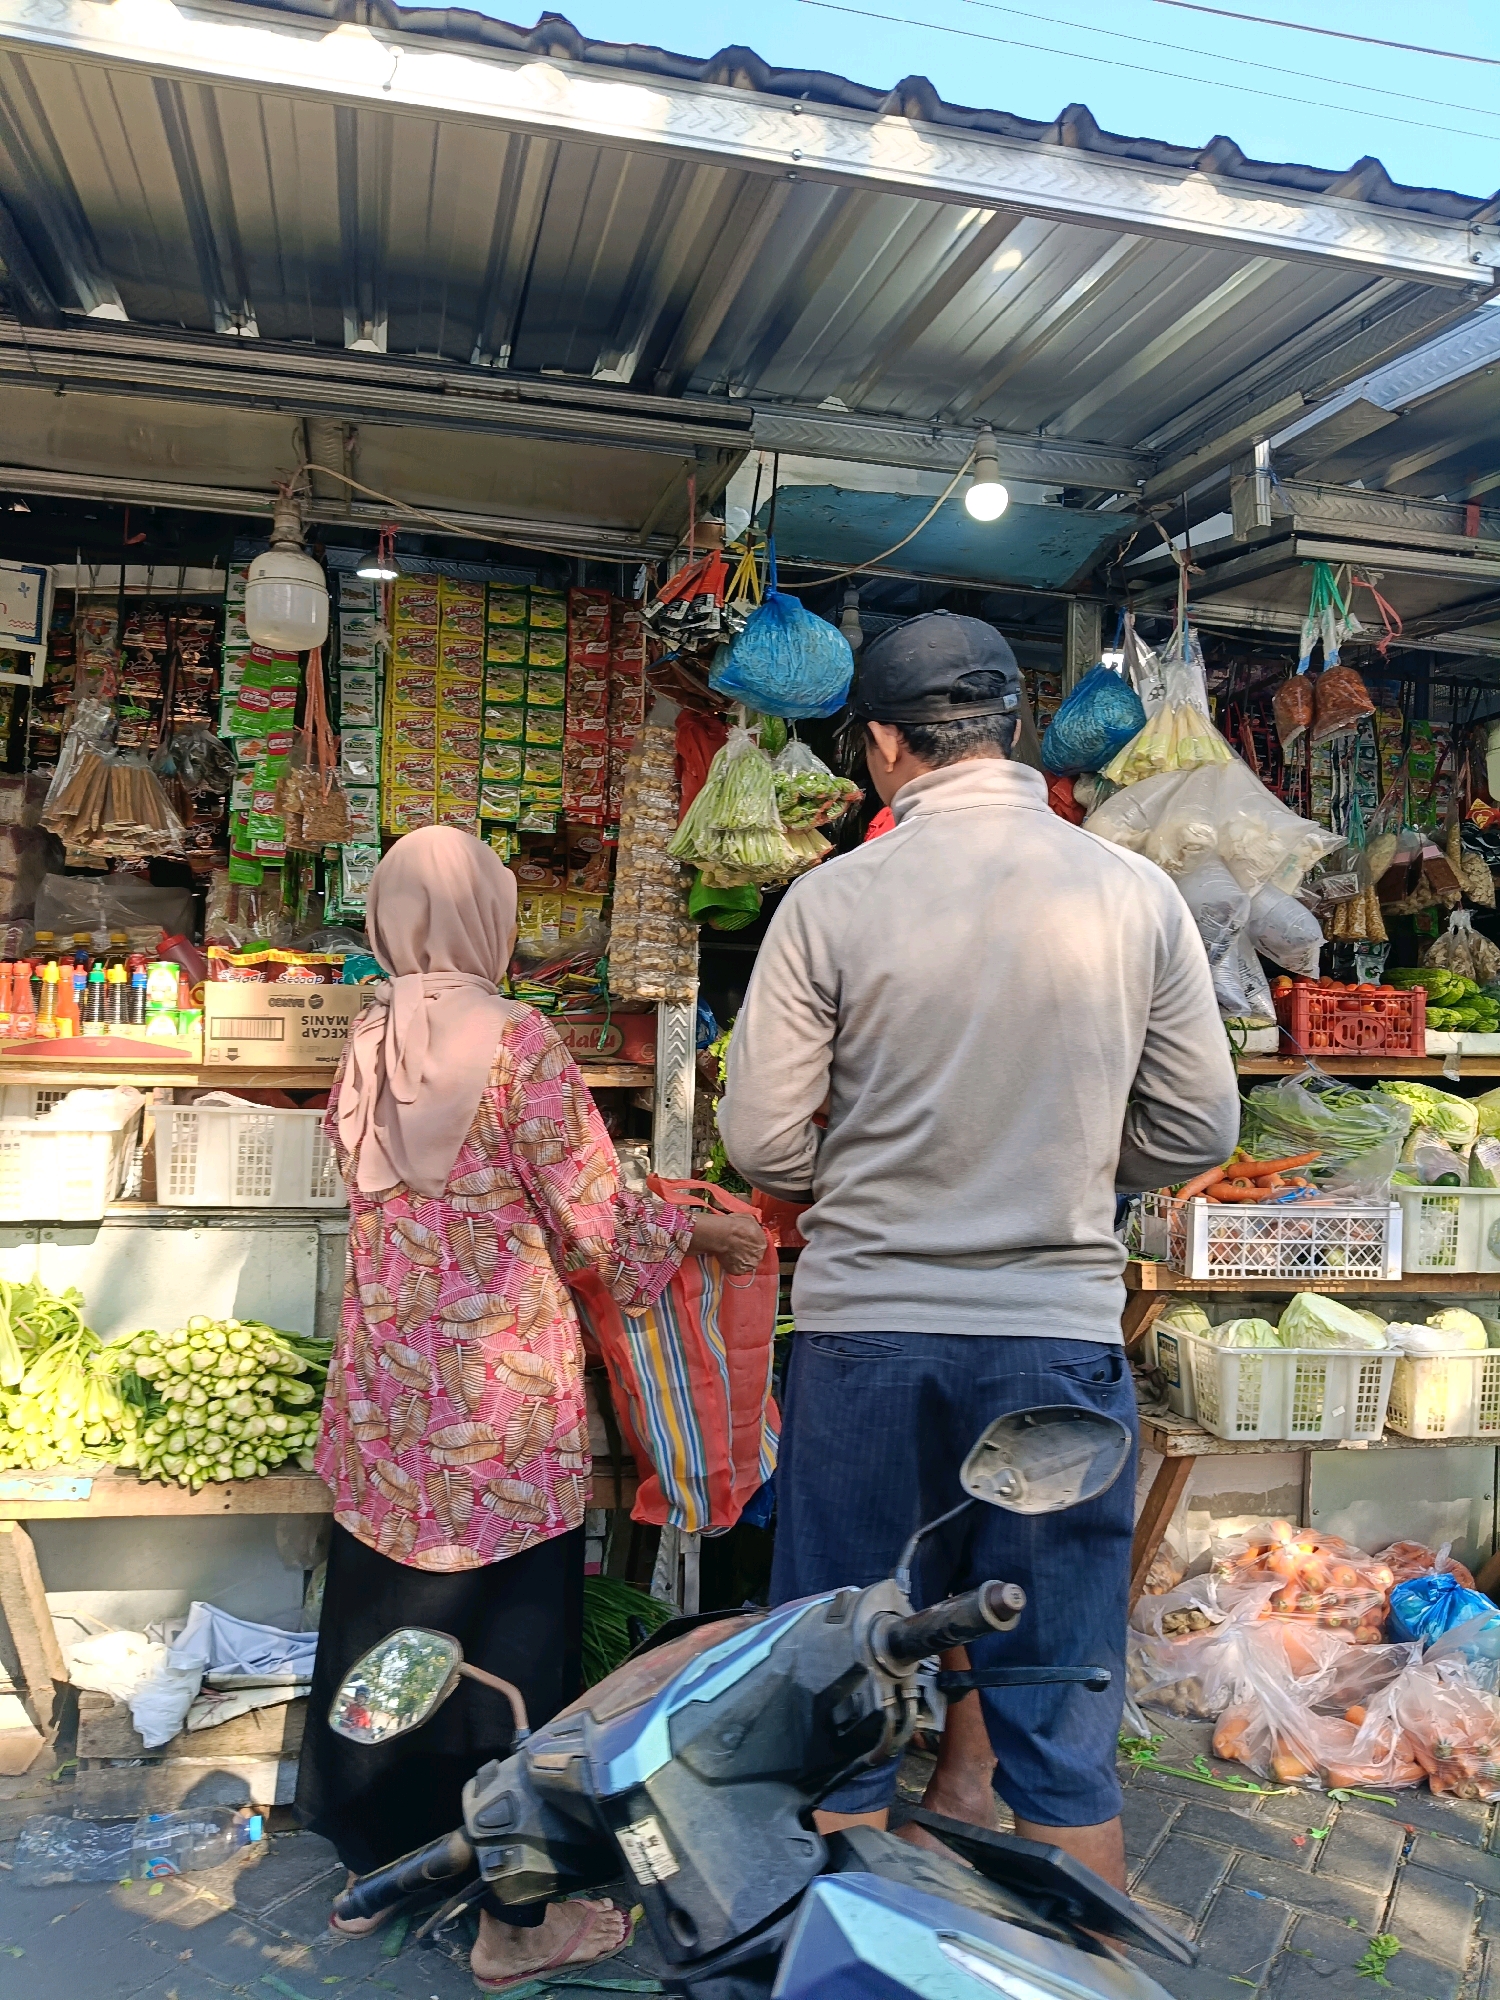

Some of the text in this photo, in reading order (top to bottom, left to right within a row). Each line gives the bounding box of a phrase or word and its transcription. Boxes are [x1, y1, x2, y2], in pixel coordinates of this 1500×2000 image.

[396, 675, 433, 687] Masako
[395, 716, 432, 728] Masako
[268, 997, 305, 1008] BANGO
[301, 1015, 349, 1026] MANIS
[302, 1028, 348, 1038] KECAP
